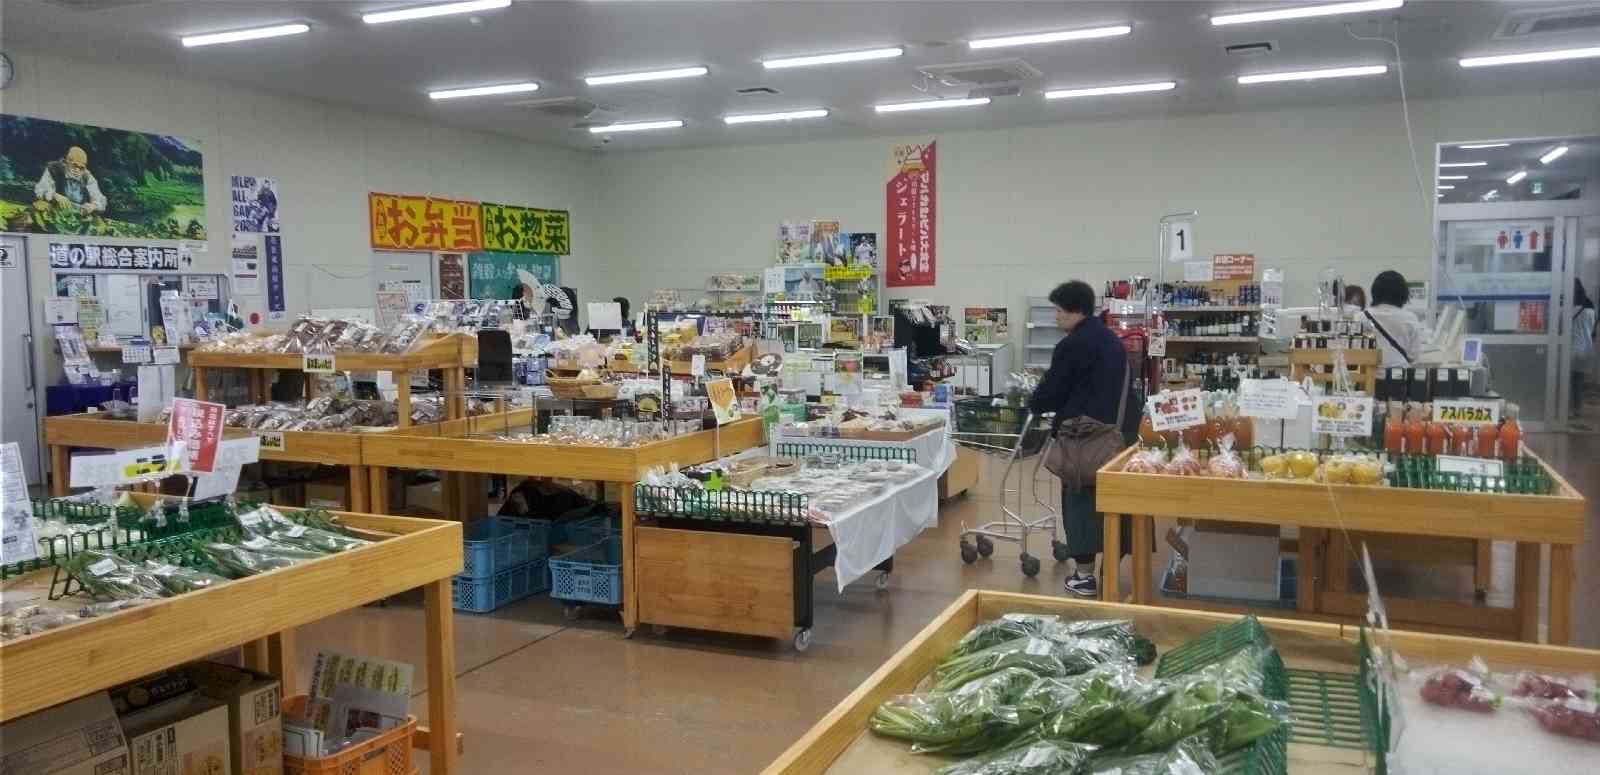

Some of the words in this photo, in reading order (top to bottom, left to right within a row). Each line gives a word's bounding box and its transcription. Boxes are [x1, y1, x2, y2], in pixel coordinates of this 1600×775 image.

[232, 190, 247, 203] ALL
[387, 200, 477, 248] お弁当
[495, 208, 566, 251] お惣菜
[896, 178, 908, 257] ジェラート
[1176, 229, 1185, 251] 1
[52, 245, 178, 269] 道の駅総合案内所
[1439, 406, 1493, 420] アスパラガス
